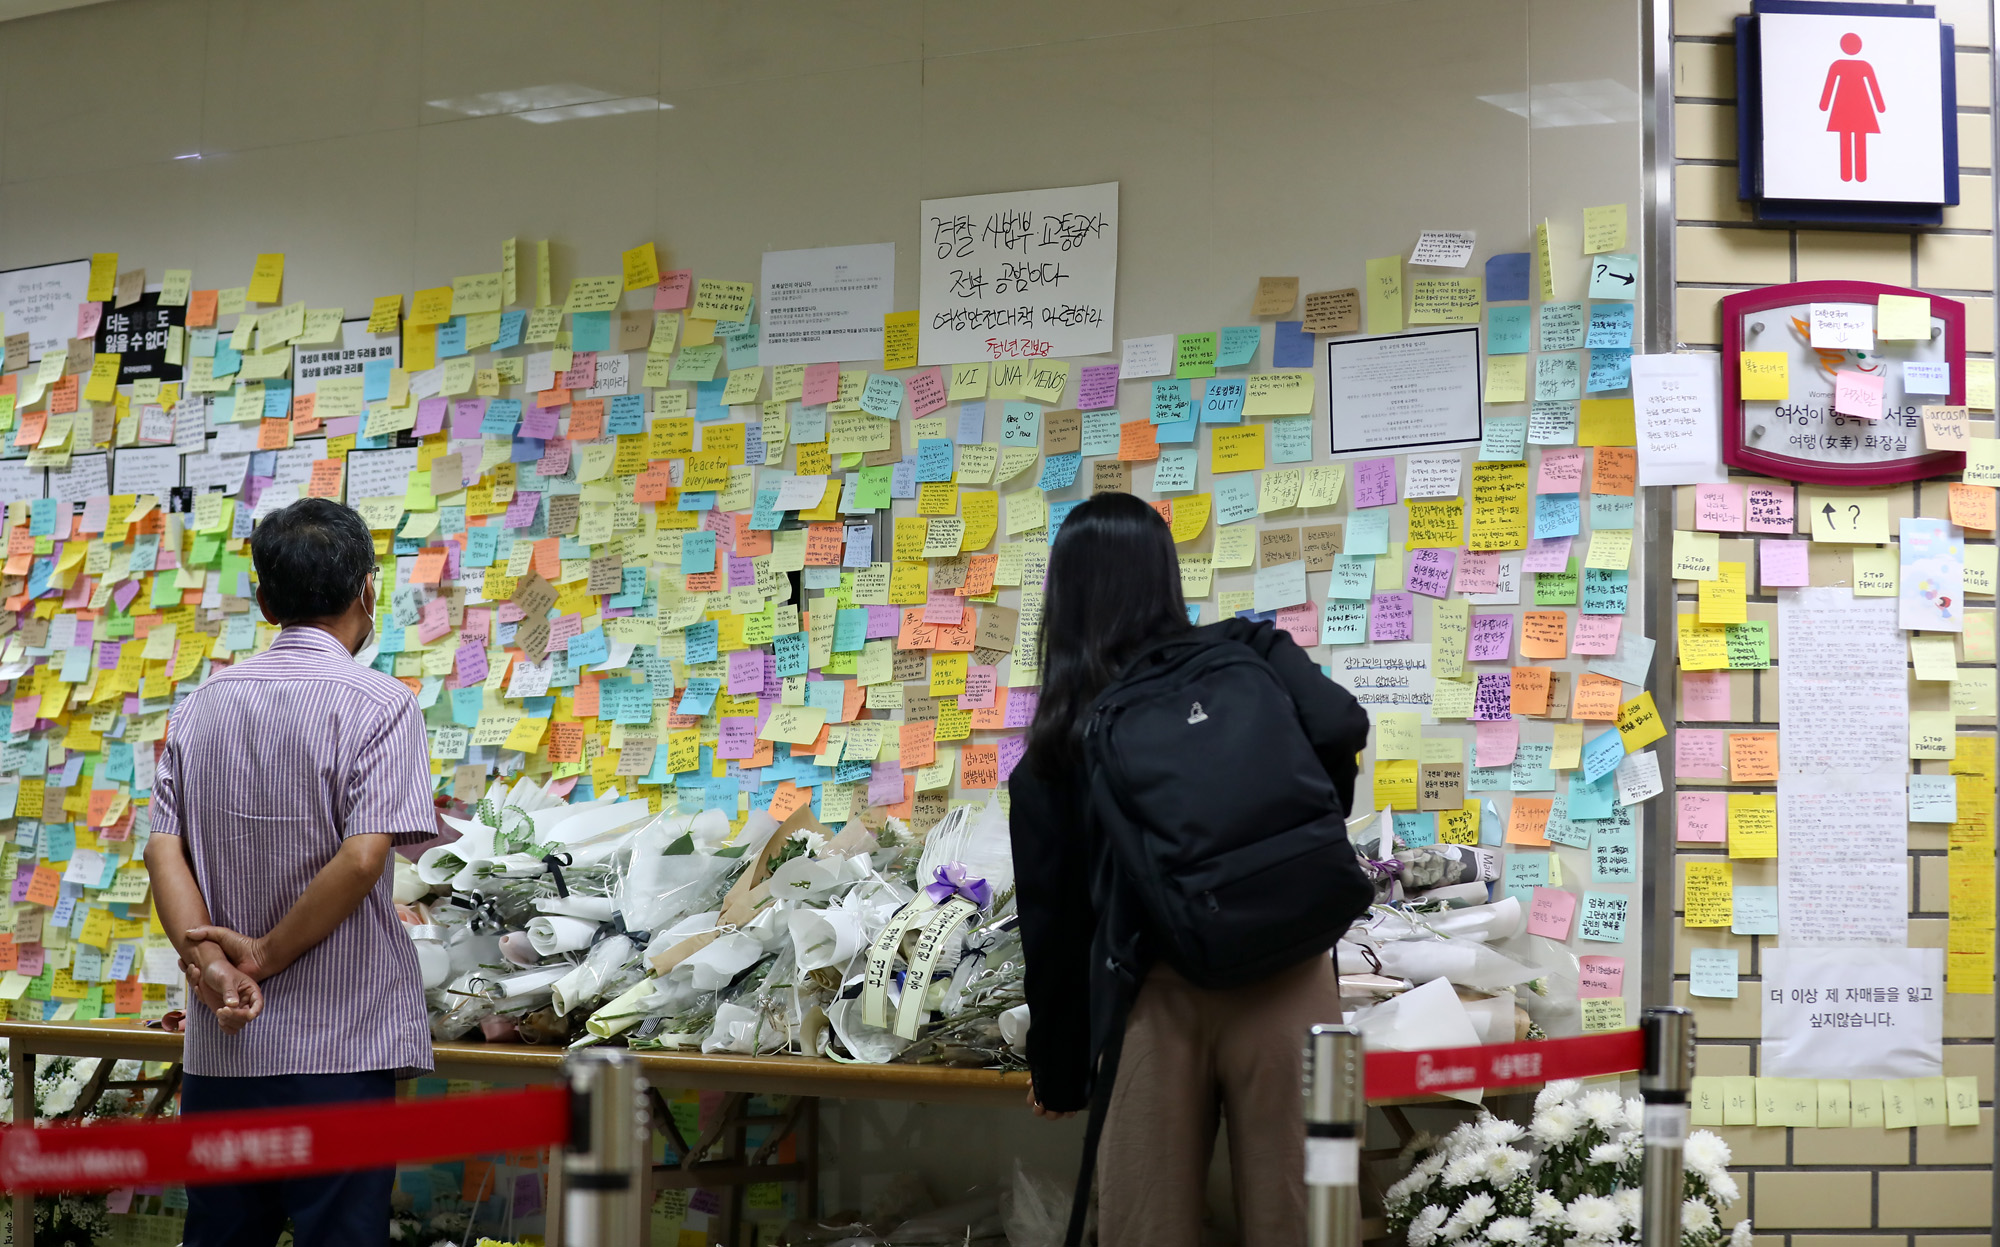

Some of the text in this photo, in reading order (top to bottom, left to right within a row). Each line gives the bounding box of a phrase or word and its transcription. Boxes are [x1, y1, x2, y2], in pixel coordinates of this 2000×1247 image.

[1596, 264, 1608, 283] ?
[950, 267, 990, 300] 전부
[106, 313, 130, 333] 더는
[933, 305, 1035, 332] 여성안전대책
[105, 334, 129, 354] 잃을
[130, 336, 143, 351] 수
[955, 368, 980, 387] NI
[994, 363, 1023, 388] UNA
[1027, 367, 1068, 393] MENOS
[1208, 384, 1243, 397] 스토킹범죄
[1207, 399, 1239, 412] OUT!
[1774, 404, 1825, 426] 여성이
[1884, 406, 1921, 428] 서울
[1924, 407, 1968, 422] Sarcasm
[1789, 434, 1908, 452] 여행(女幸) 화장실
[688, 455, 728, 473] Peace for
[1975, 463, 1995, 471] STOP
[1967, 471, 2000, 480] FEMICIDE
[1848, 504, 1861, 530] ?
[1676, 563, 1711, 572] FEMICIDE
[1963, 568, 1986, 577] STOP
[1858, 580, 1894, 589] FEMICIDE
[1963, 577, 1990, 588] MICIDE
[1915, 743, 1948, 752] FEMICIDE
[1922, 735, 1943, 743] STOP
[1687, 821, 1709, 830] PEACE
[1770, 986, 1934, 1004] 더 이상 제 자매들을 잃고
[1809, 1011, 1896, 1028] 싶지않습니다.
